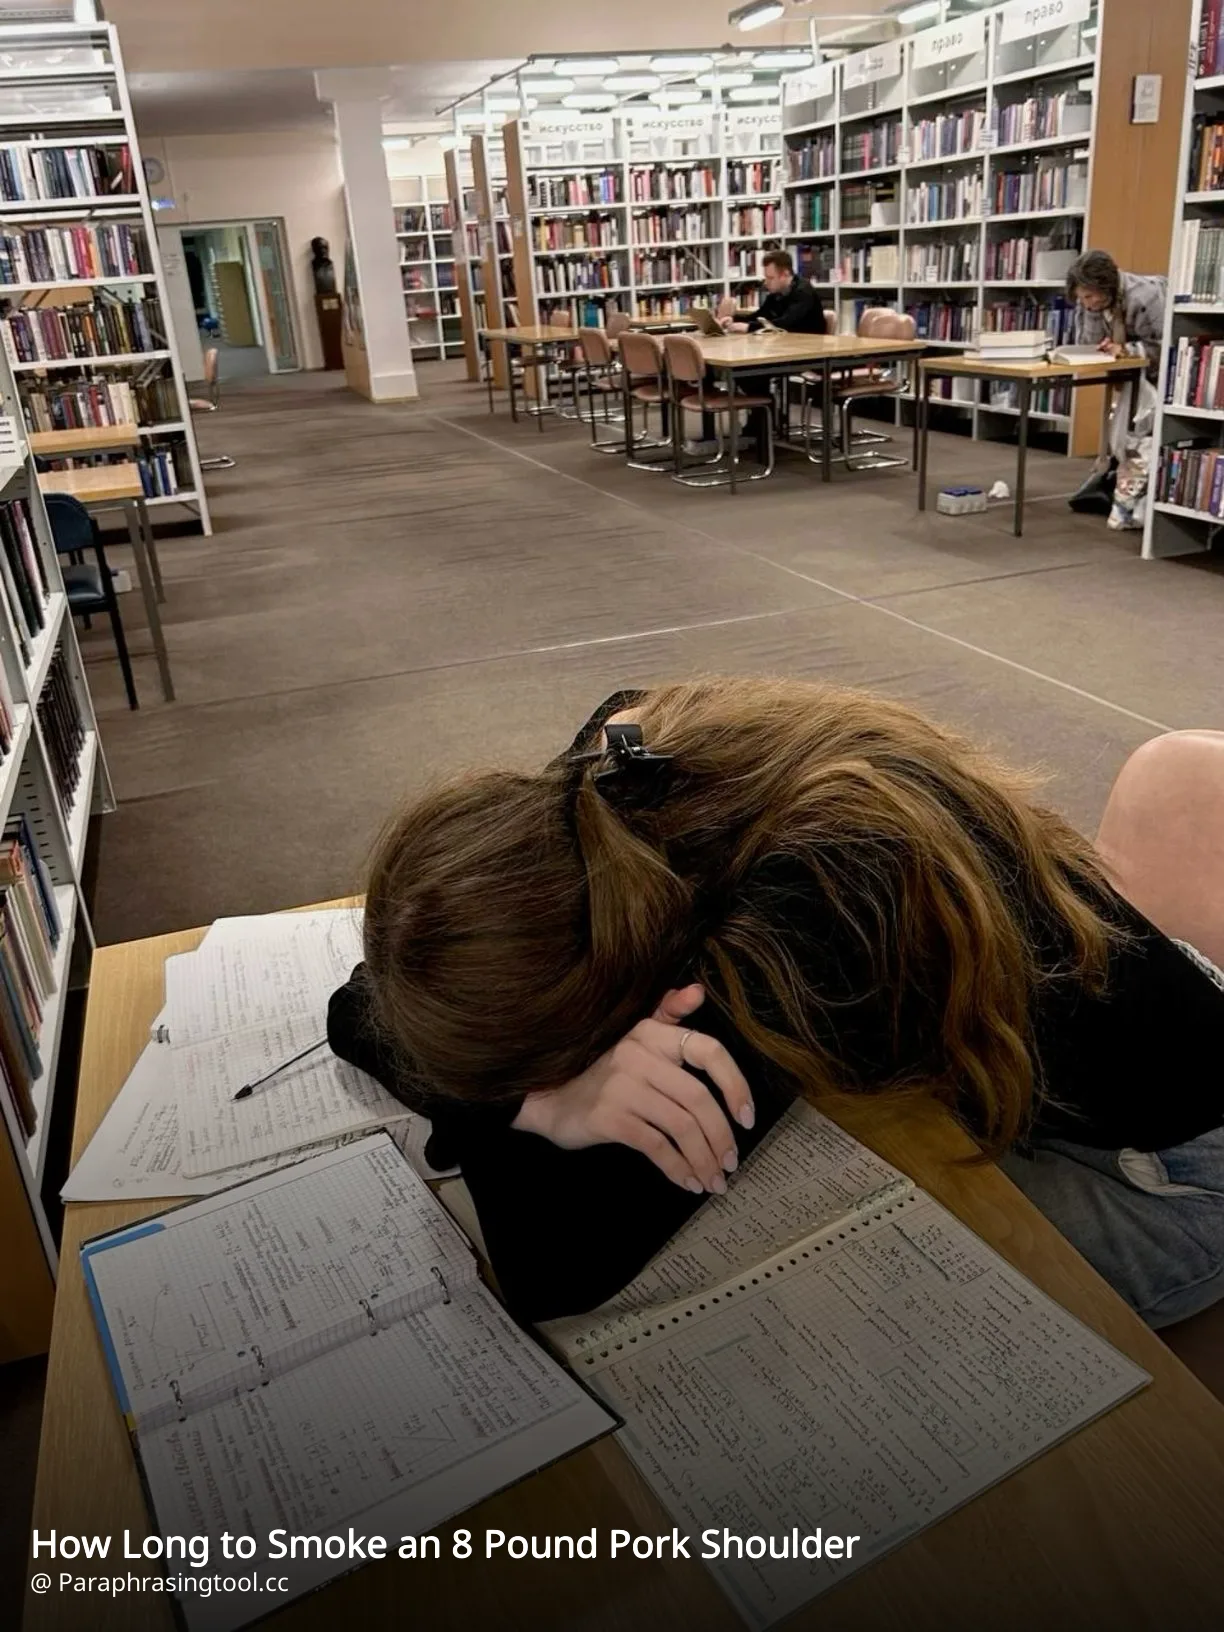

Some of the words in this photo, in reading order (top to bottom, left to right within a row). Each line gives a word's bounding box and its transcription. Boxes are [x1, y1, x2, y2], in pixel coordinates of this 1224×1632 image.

[1024, 1, 1063, 26] право
[540, 123, 604, 134] искусство
[643, 119, 704, 130] искусство
